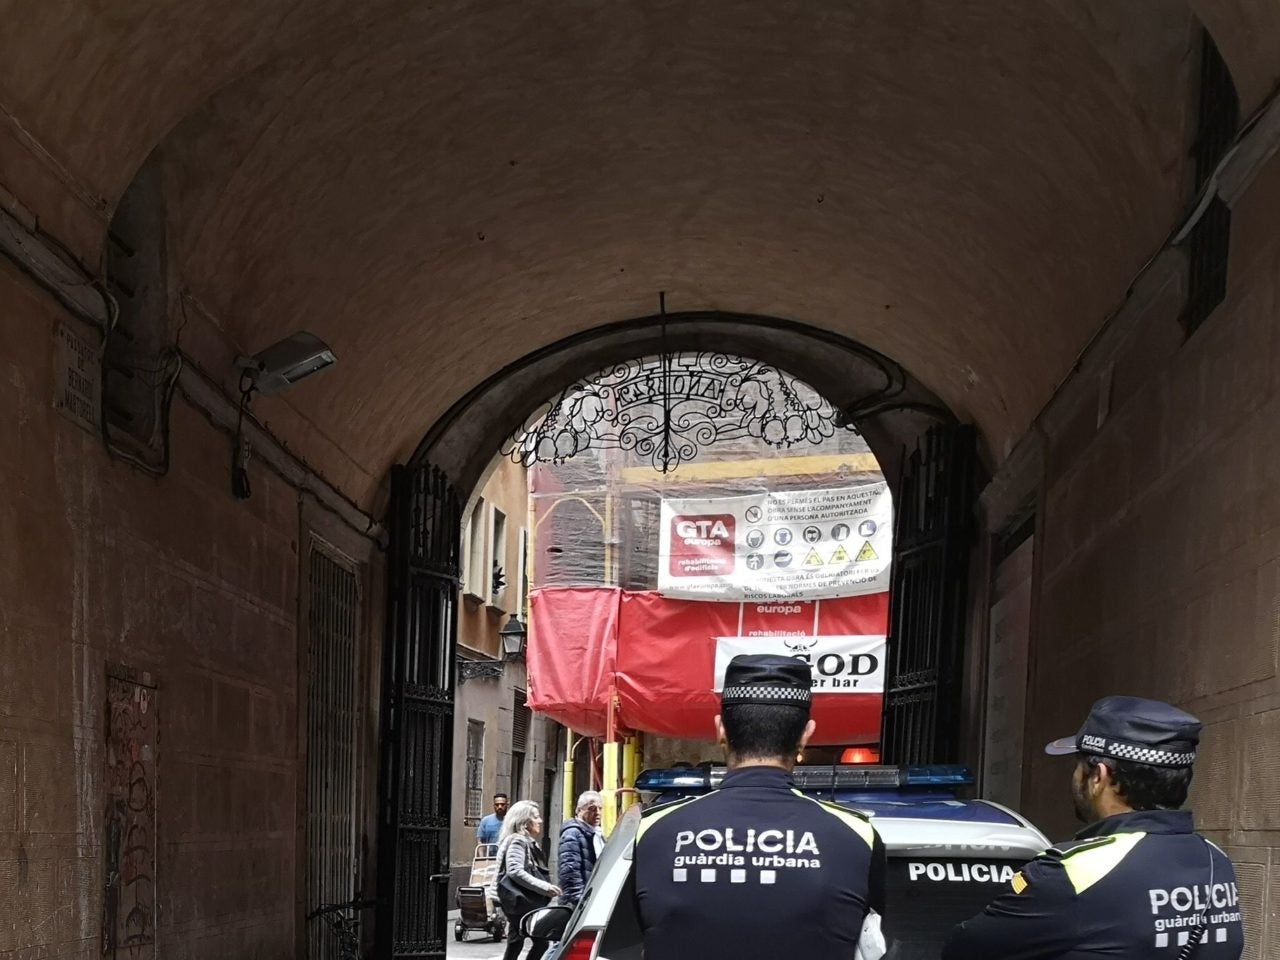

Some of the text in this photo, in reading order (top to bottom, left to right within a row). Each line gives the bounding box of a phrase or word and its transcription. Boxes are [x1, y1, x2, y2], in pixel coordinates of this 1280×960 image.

[821, 507, 868, 519] AUTORITZADA
[676, 520, 730, 538] GTA
[684, 539, 721, 547] europa
[757, 605, 801, 615] europa
[832, 678, 859, 687] bar
[675, 828, 820, 854] POLICIA
[674, 853, 821, 868] guàrdia urbana
[908, 862, 1014, 883] POLICIA
[1211, 911, 1241, 924] urban
